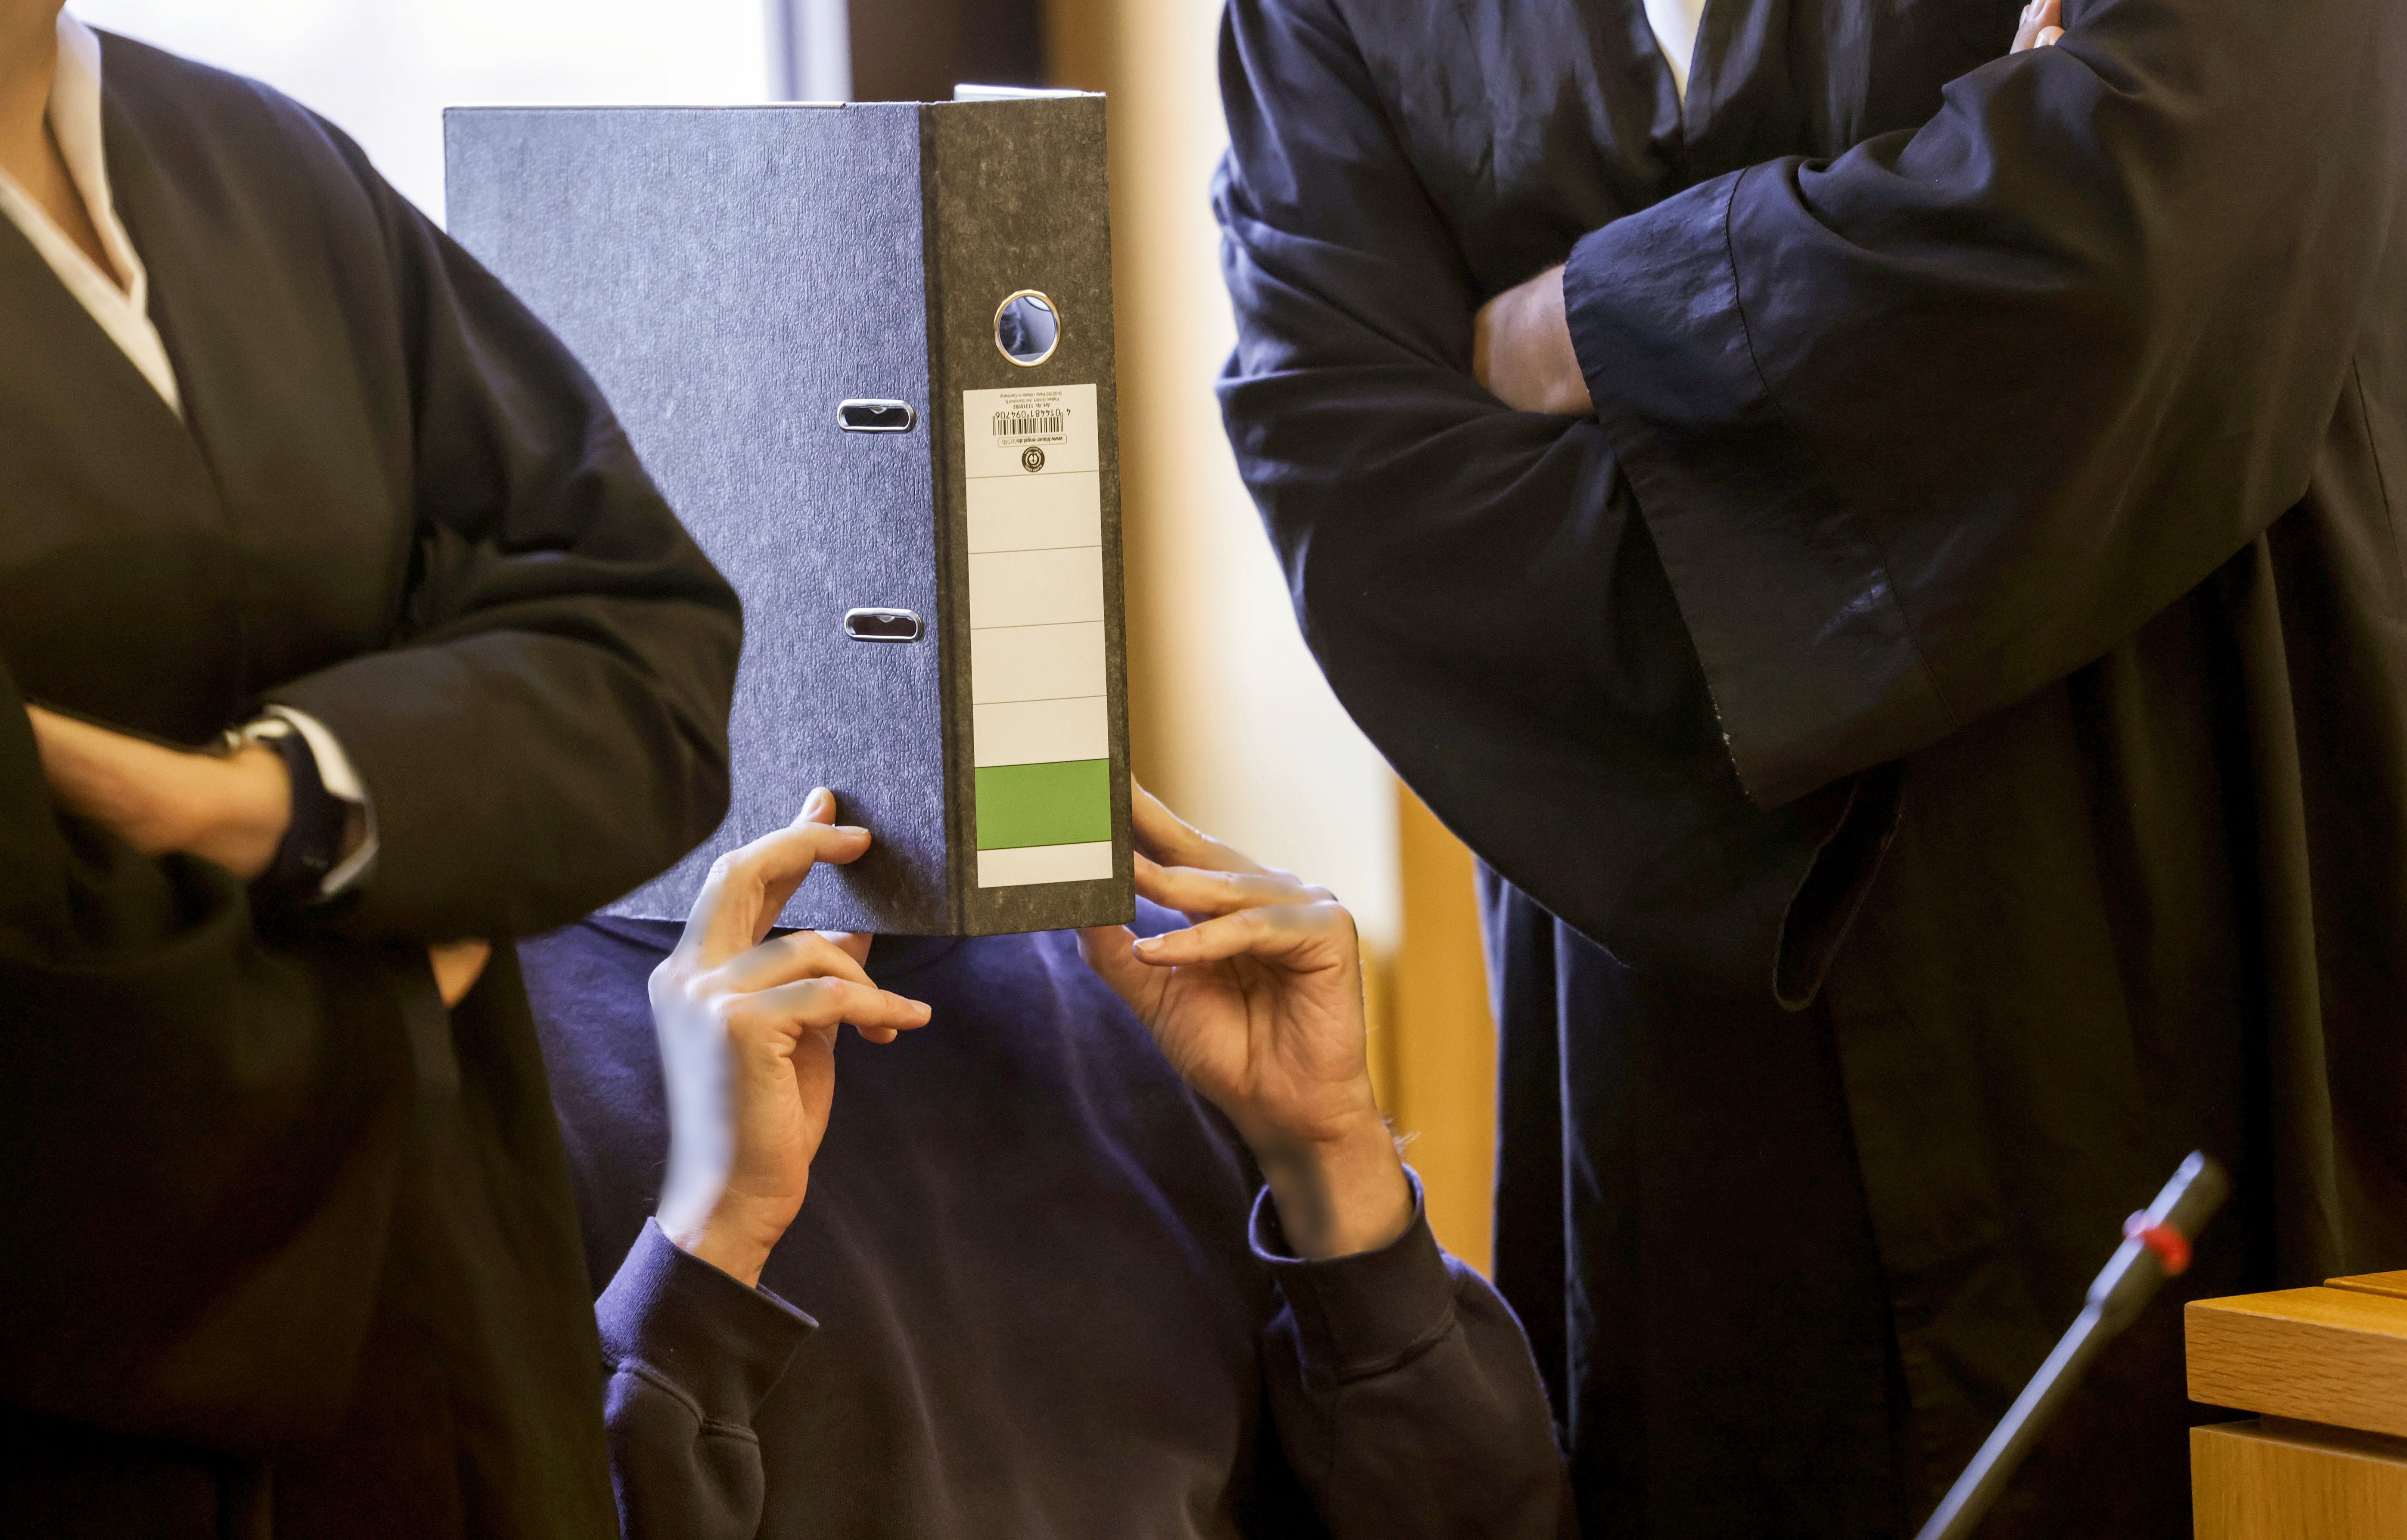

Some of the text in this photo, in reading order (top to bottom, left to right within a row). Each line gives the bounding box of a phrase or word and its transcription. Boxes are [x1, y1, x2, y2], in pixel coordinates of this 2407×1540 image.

[995, 410, 1026, 419] 094706
[1031, 409, 1060, 417] 014481
[1002, 436, 1063, 445] www.blauer-engel.de/uz14b
